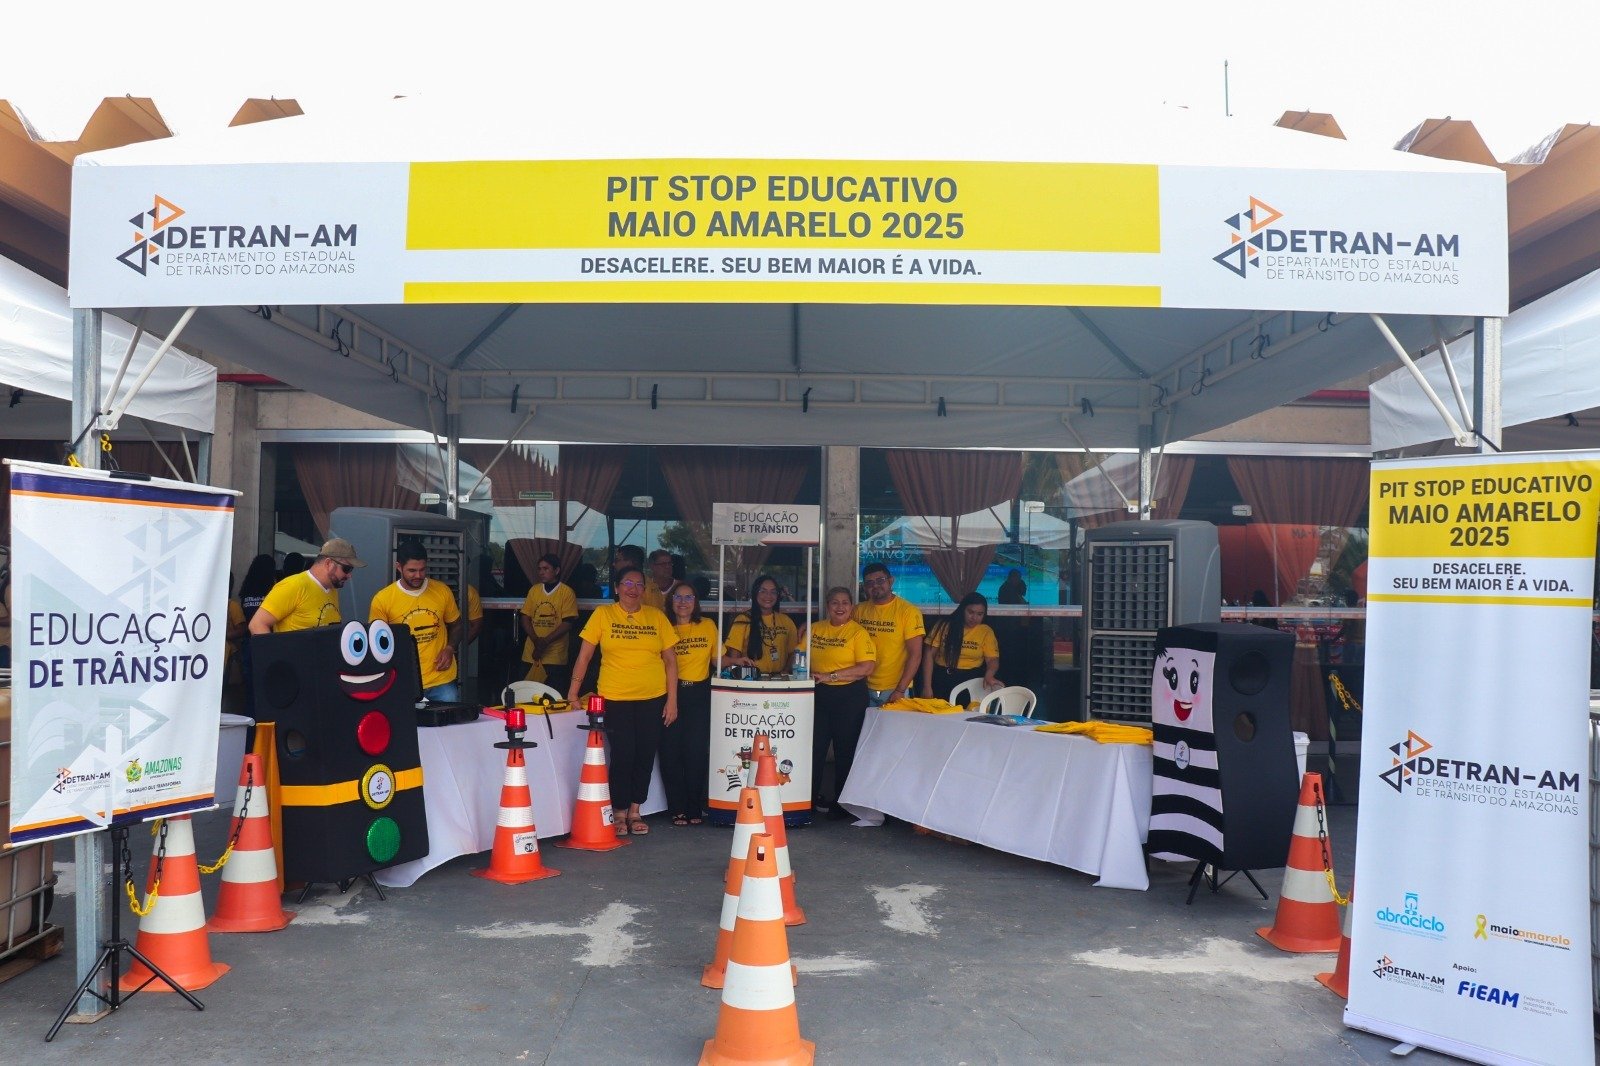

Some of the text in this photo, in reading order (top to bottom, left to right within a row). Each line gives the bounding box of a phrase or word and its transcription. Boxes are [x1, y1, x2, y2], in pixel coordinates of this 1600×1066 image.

[606, 176, 958, 203] PIT STOP EDUCATIVO
[608, 211, 965, 239] MAIO AMARELO 2025
[167, 224, 357, 249] DETRAN-AM
[1266, 229, 1459, 257] DETRAN-AM
[166, 251, 356, 264] DEPARTAMENTO ESTADUAL
[580, 254, 982, 276] DESACELERE. SEU BEM MAIOR É A VIDA.
[1266, 256, 1459, 272] DEPARTAMENTO ESTADUAL
[166, 263, 355, 276] DE TRÂNSITO DO AMAZONAS
[1266, 268, 1459, 285] DE TRÂNSITO DO AMAZONAS
[1379, 474, 1592, 498] PIT STOP EDUCATIVO
[734, 511, 799, 525] EDUCAÇÃO
[1389, 501, 1581, 524] MAIO AMARELO
[733, 523, 799, 534] DE TRÂNSITO
[1450, 526, 1510, 547] 2025
[1433, 563, 1526, 575] DESACELERE.
[1393, 576, 1574, 592] SEU BEM MAIOR É A VIDA.
[30, 606, 211, 652] EDUCAÇÃO
[611, 622, 657, 631] DESACELERE.
[29, 650, 209, 688] DE TRÂNSITO
[725, 713, 796, 728] EDUCAÇÃO
[724, 727, 795, 739] DE TRÂNSITO
[144, 757, 183, 776] AMAZONAS
[1417, 756, 1580, 793] DETRAN-AM
[66, 771, 111, 784] DETRAN-AM
[1417, 777, 1579, 805] DEPARTAMENTO ESTADUAL
[1416, 787, 1579, 816] DE TRÂNSITO DO AMAZONAS
[525, 843, 534, 852] 36
[1376, 906, 1445, 932] abraciclo
[1387, 965, 1445, 985] DETRAN-AM
[1452, 963, 1477, 974] Apoio:
